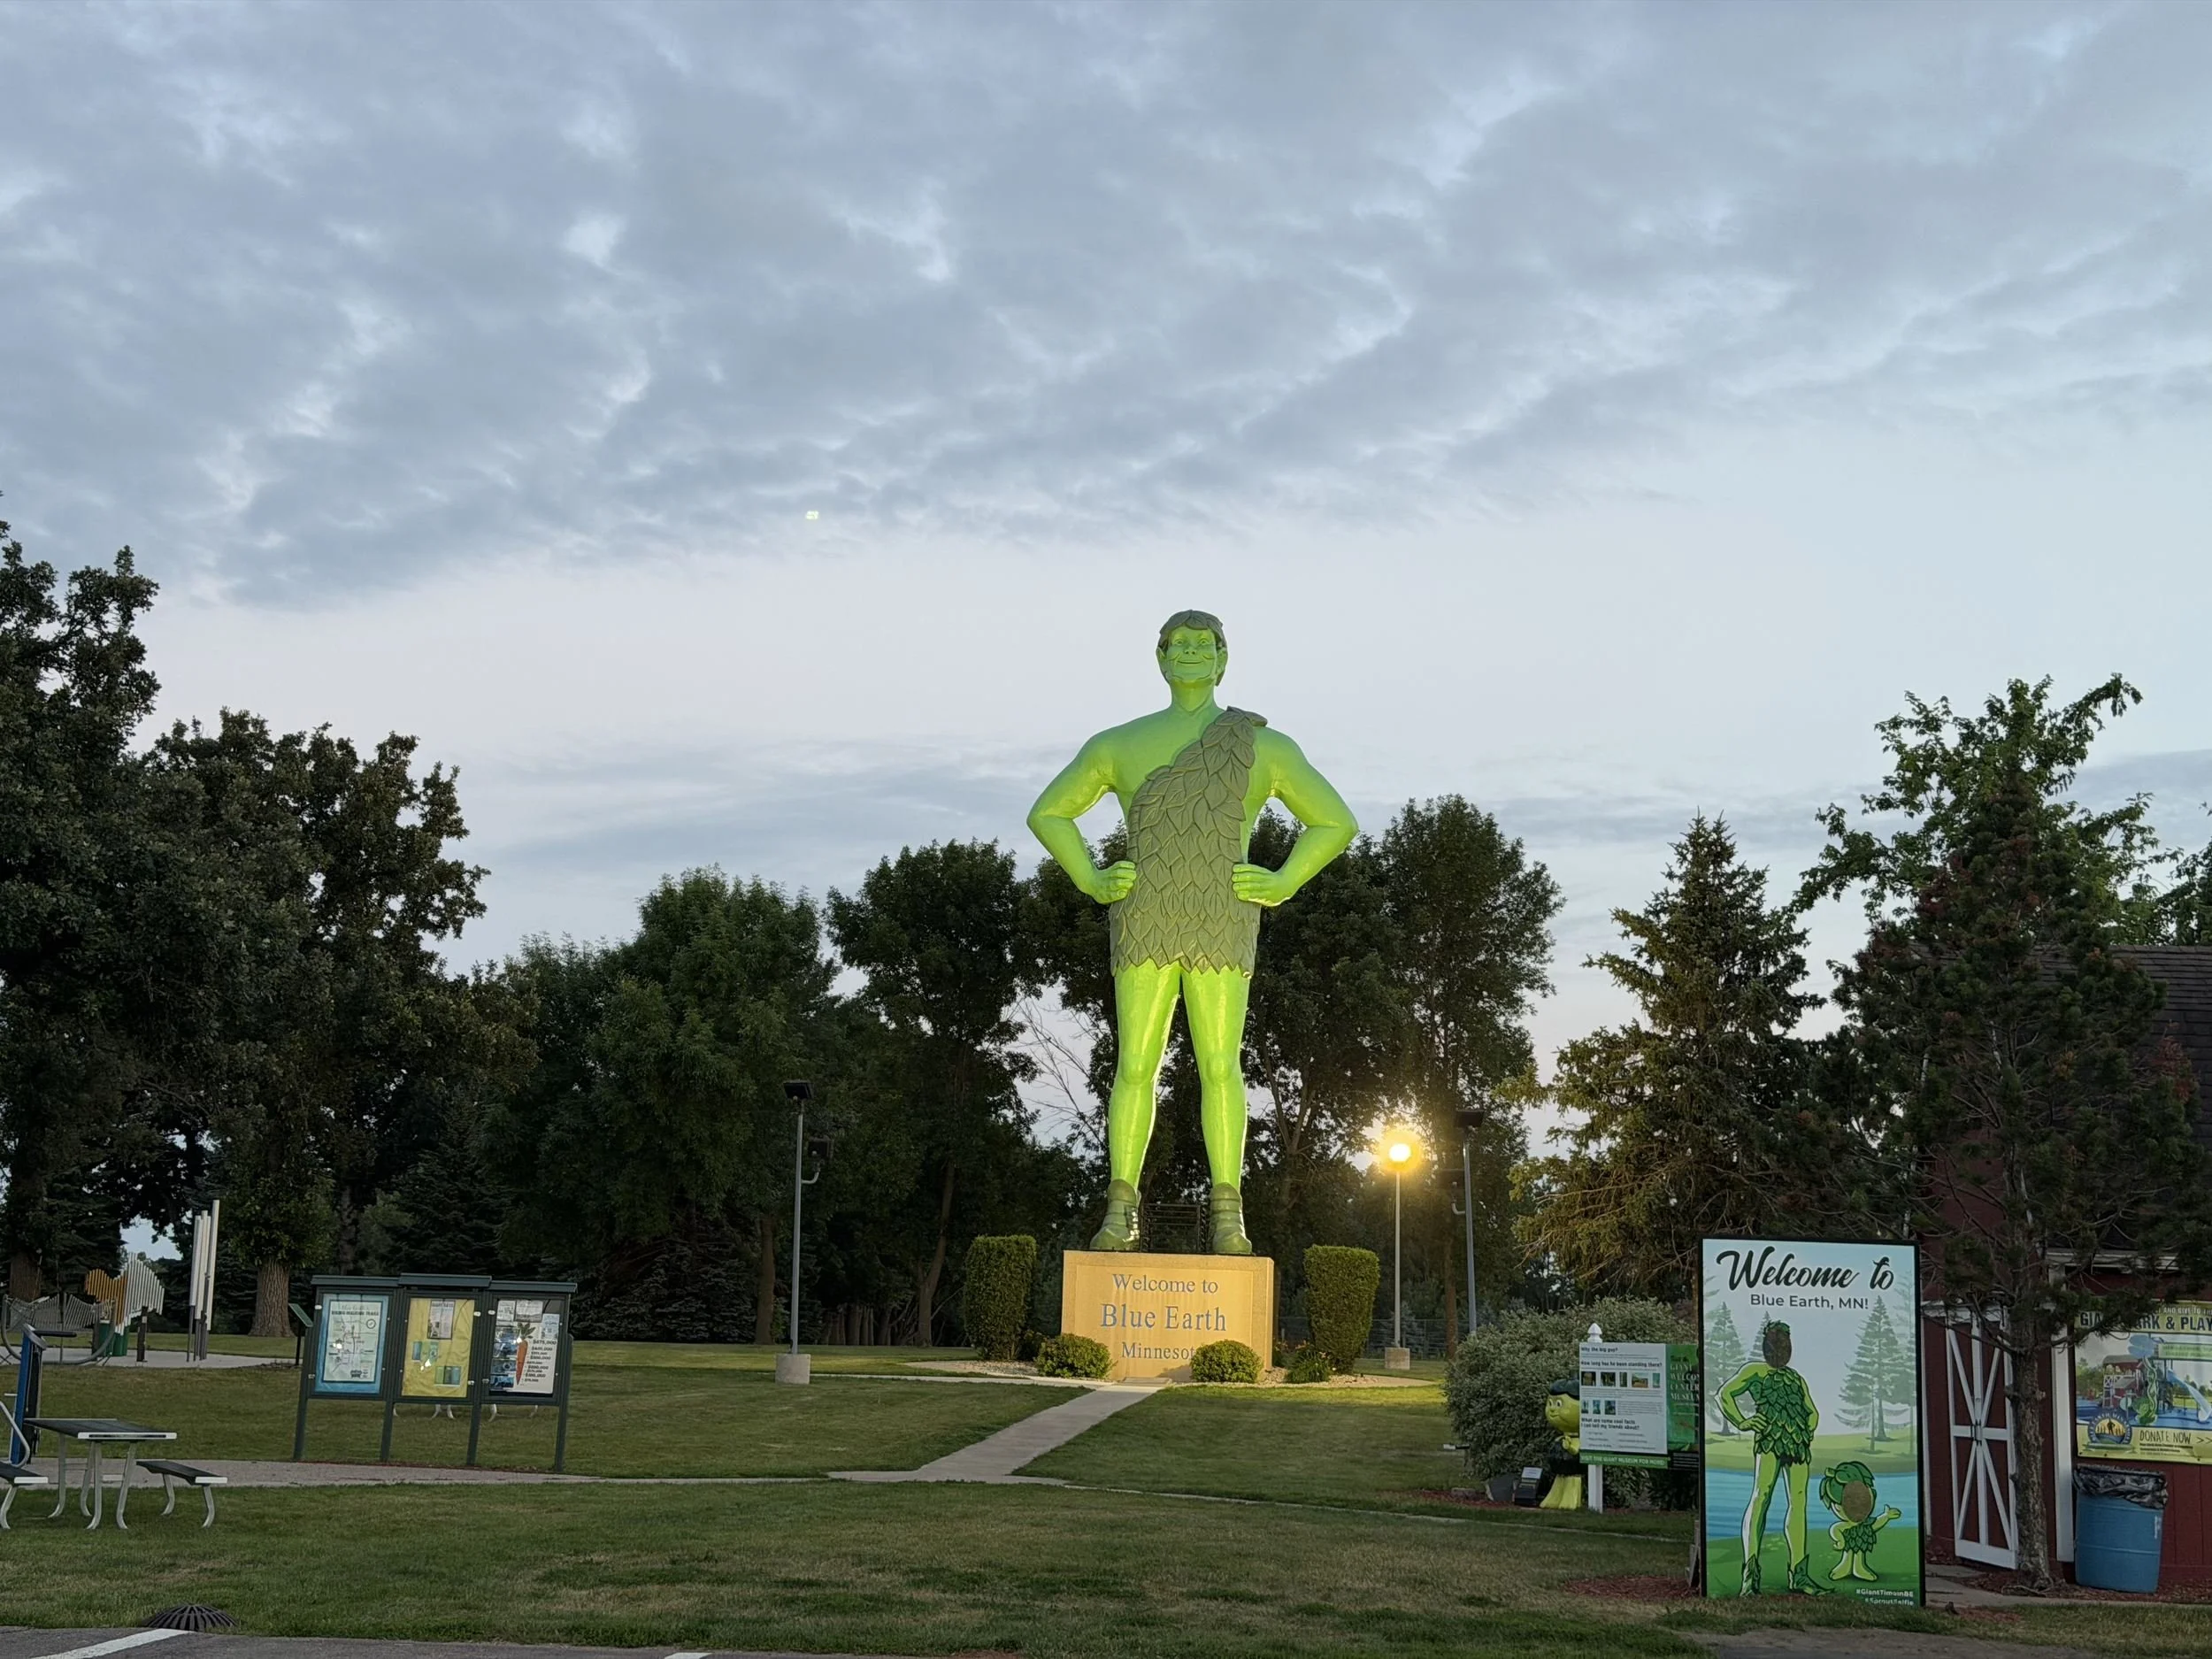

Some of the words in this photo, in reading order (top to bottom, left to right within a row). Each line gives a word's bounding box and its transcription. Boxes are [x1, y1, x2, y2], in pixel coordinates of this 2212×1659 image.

[1716, 1245, 1860, 1291] Welcome
[1869, 1256, 1894, 1290] to
[1112, 1273, 1195, 1293] Welcome
[1202, 1279, 1218, 1294] to
[1750, 1294, 1785, 1306] Blue
[1789, 1295, 1834, 1310] Earth,
[1839, 1297, 1869, 1310] MN!
[1100, 1303, 1156, 1328] Blue
[1165, 1305, 1226, 1331] Earth
[2166, 1316, 2175, 1330] &
[1121, 1341, 1195, 1359] Minnesot
[2139, 1429, 2170, 1443] DONATE
[2173, 1432, 2192, 1445] NOW
